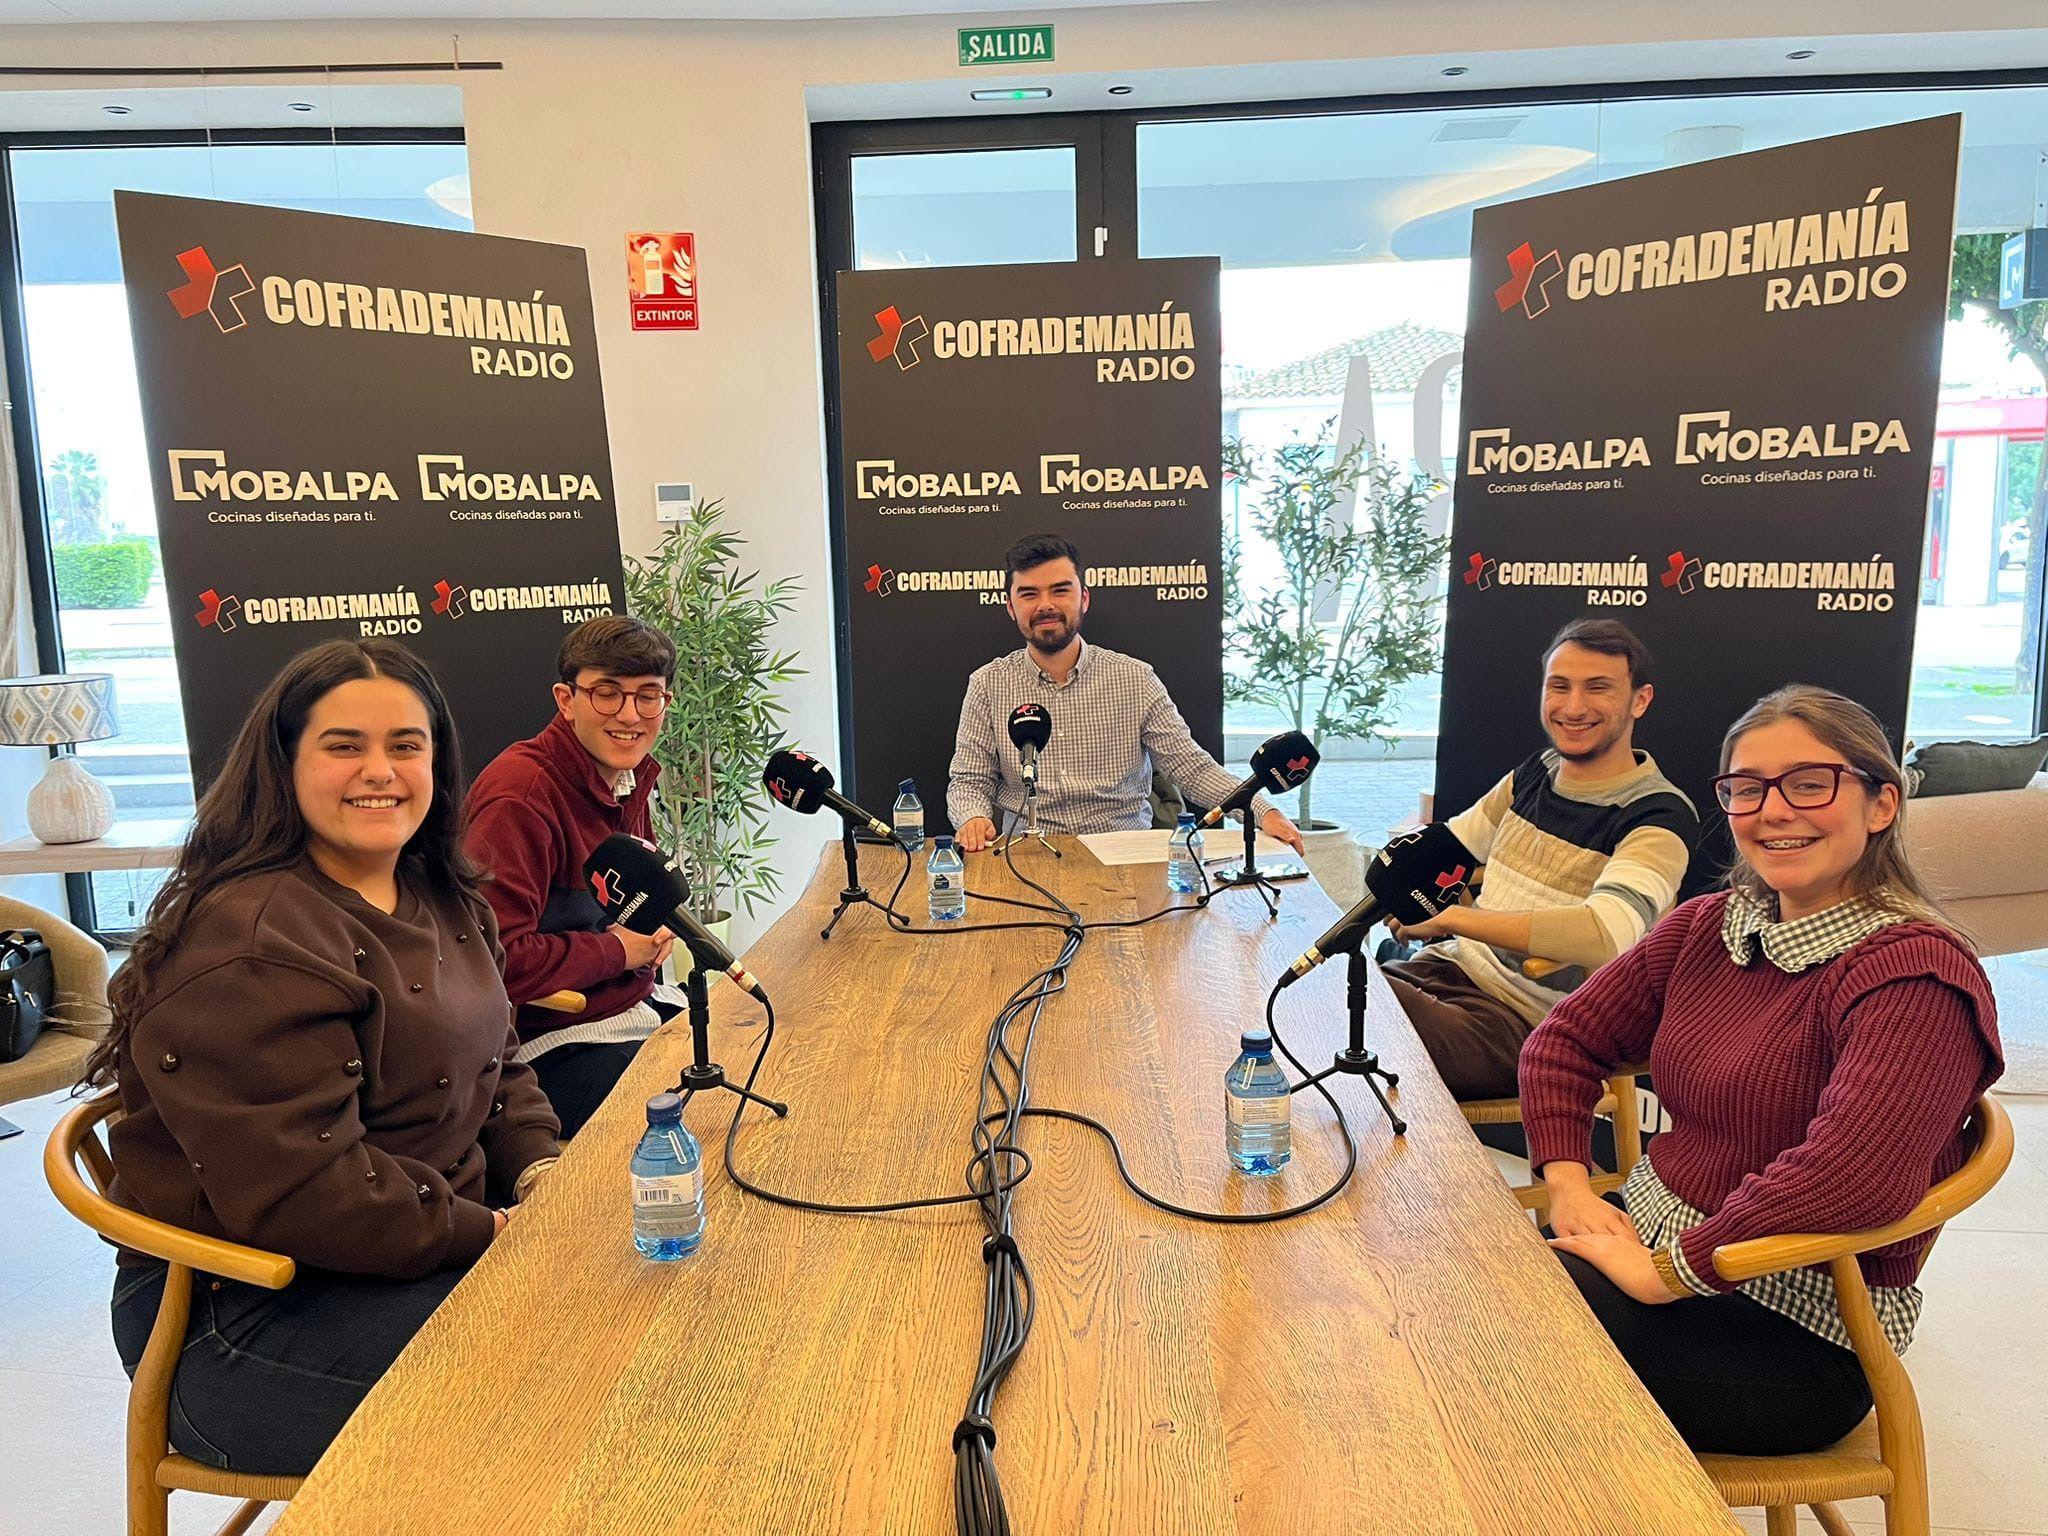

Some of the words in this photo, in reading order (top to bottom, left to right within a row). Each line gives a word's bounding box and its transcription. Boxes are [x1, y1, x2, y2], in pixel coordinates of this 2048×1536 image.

[968, 32, 1046, 58] SALIDA
[1566, 186, 1910, 301] COFRADEMANÍA
[1765, 262, 1907, 312] RADIO
[261, 275, 571, 347] COFRADEMANÍA
[636, 309, 693, 322] EXTINTOR
[933, 300, 1195, 359] COFRADEMANÍA
[470, 345, 574, 380] RADIO
[1096, 355, 1195, 383] RADIO
[1696, 419, 1911, 463] MOBALPA
[1483, 437, 1651, 474] MOBALPA
[193, 469, 400, 501] MOBALPA
[438, 472, 602, 501] MOBALPA
[872, 471, 1022, 499] MOBALPA
[1056, 465, 1210, 493] MOBALPA
[1487, 482, 1529, 494] Cocinas
[1529, 480, 1583, 492] diseñadas
[1585, 480, 1611, 491] para
[1613, 478, 1625, 489] ti.
[1700, 473, 1752, 485] Cocinas
[1754, 470, 1823, 483] diseñadas
[1826, 469, 1859, 482] para
[1863, 467, 1877, 478] ti.
[207, 511, 262, 523] Cocinas
[265, 510, 331, 522] diseñadas
[333, 513, 362, 524] para
[364, 511, 377, 522] ti.
[449, 510, 493, 521] Cocinas
[494, 509, 547, 520] diseñadas
[549, 511, 572, 521] para
[573, 510, 584, 520] ti.
[878, 505, 917, 515] Cocinas
[918, 504, 966, 514] diseñadas
[968, 504, 990, 515] para
[991, 503, 1002, 512] ti.
[1062, 500, 1101, 510] Cocinas
[1102, 498, 1152, 509] diseñadas
[1154, 499, 1176, 509] para
[1178, 498, 1188, 507] ti.
[897, 570, 1006, 592] COFRADEMA
[1083, 558, 1208, 588] OFRADEMANÍA
[1498, 554, 1649, 587] COFRADEMANÍA
[1703, 553, 1895, 590] COFRADEMANÍA
[243, 584, 421, 625] COFRADEMANÍA
[469, 576, 612, 612] COFRADEMANÍA
[979, 591, 1008, 605] RAD
[1156, 586, 1208, 601] RADIO
[1587, 589, 1648, 607] RADIO
[1817, 592, 1894, 612] RADIO
[359, 617, 422, 637] RADIO
